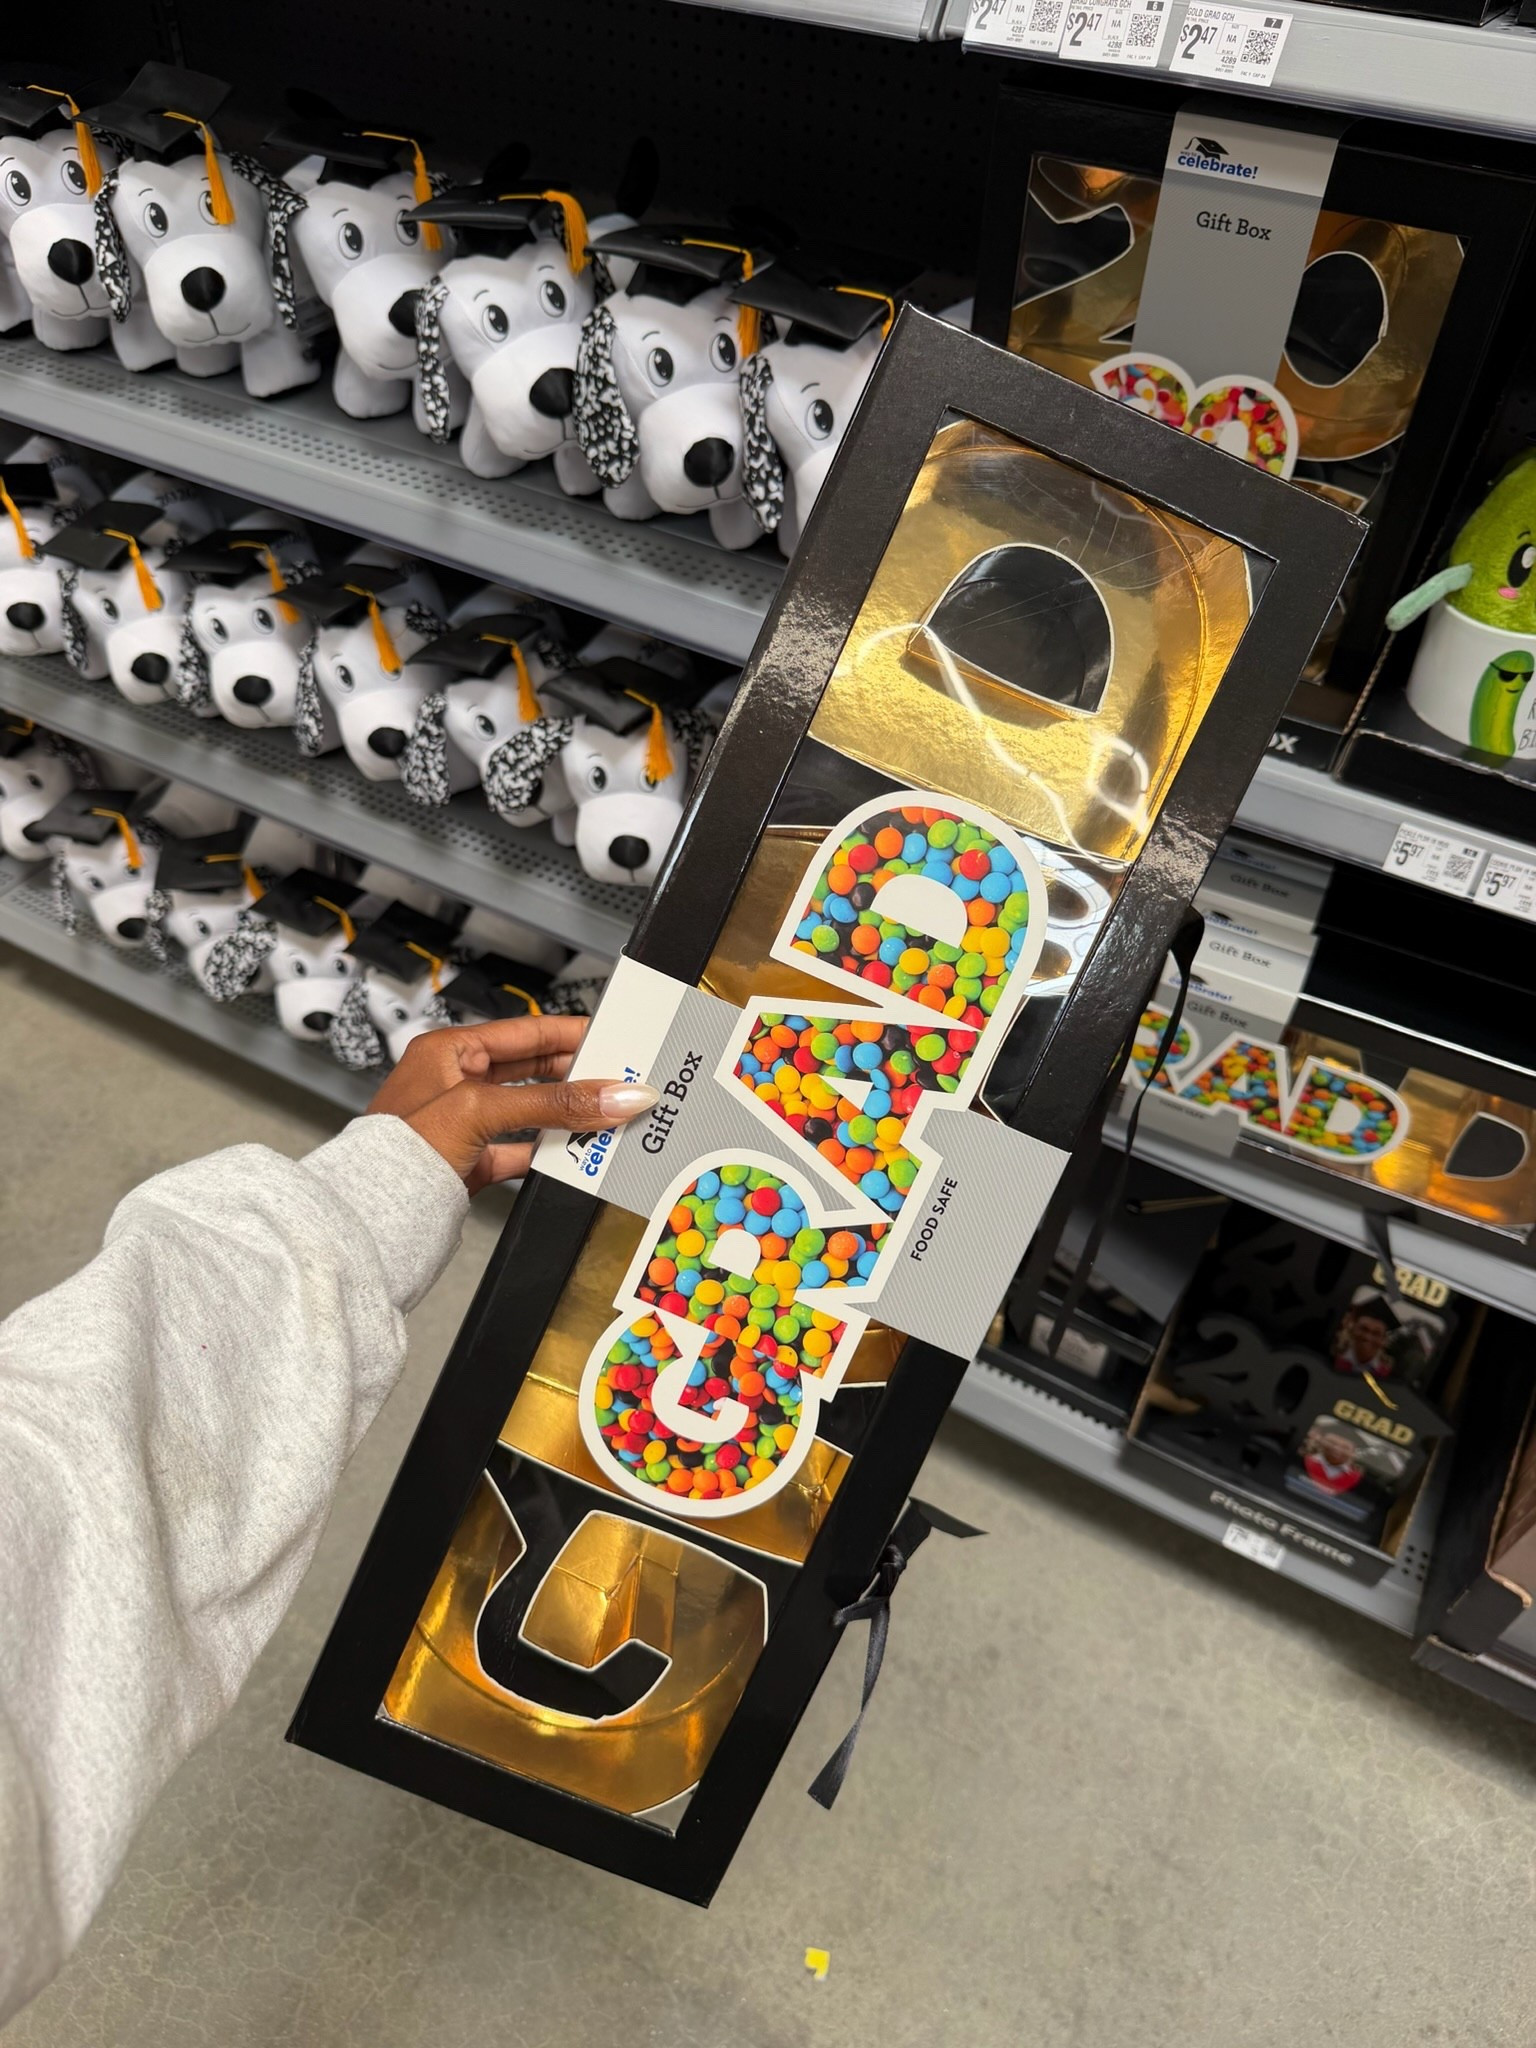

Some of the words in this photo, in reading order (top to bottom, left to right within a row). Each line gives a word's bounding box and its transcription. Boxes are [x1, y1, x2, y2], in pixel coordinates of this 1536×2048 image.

[1111, 20, 1122, 28] NA
[1187, 7, 1203, 17] GOLD
[1203, 10, 1221, 20] GRAD
[1221, 13, 1236, 21] GCH
[1226, 34, 1237, 43] NA
[1220, 56, 1238, 65] 4289
[1177, 154, 1259, 180] celebrate!
[1196, 210, 1232, 233] Gift
[1235, 218, 1272, 241] Box
[1209, 939, 1239, 958] Gift
[1187, 1001, 1217, 1018] Gift
[641, 1103, 679, 1154] Gift
[663, 1050, 703, 1102] Box
[578, 789, 1049, 1518] GRAD
[910, 1217, 939, 1262] FOOD
[932, 1177, 958, 1216] SAFE
[1333, 1398, 1416, 1447] GRAD
[1209, 1489, 1278, 1532] Photo
[1279, 1521, 1356, 1568] Frame
